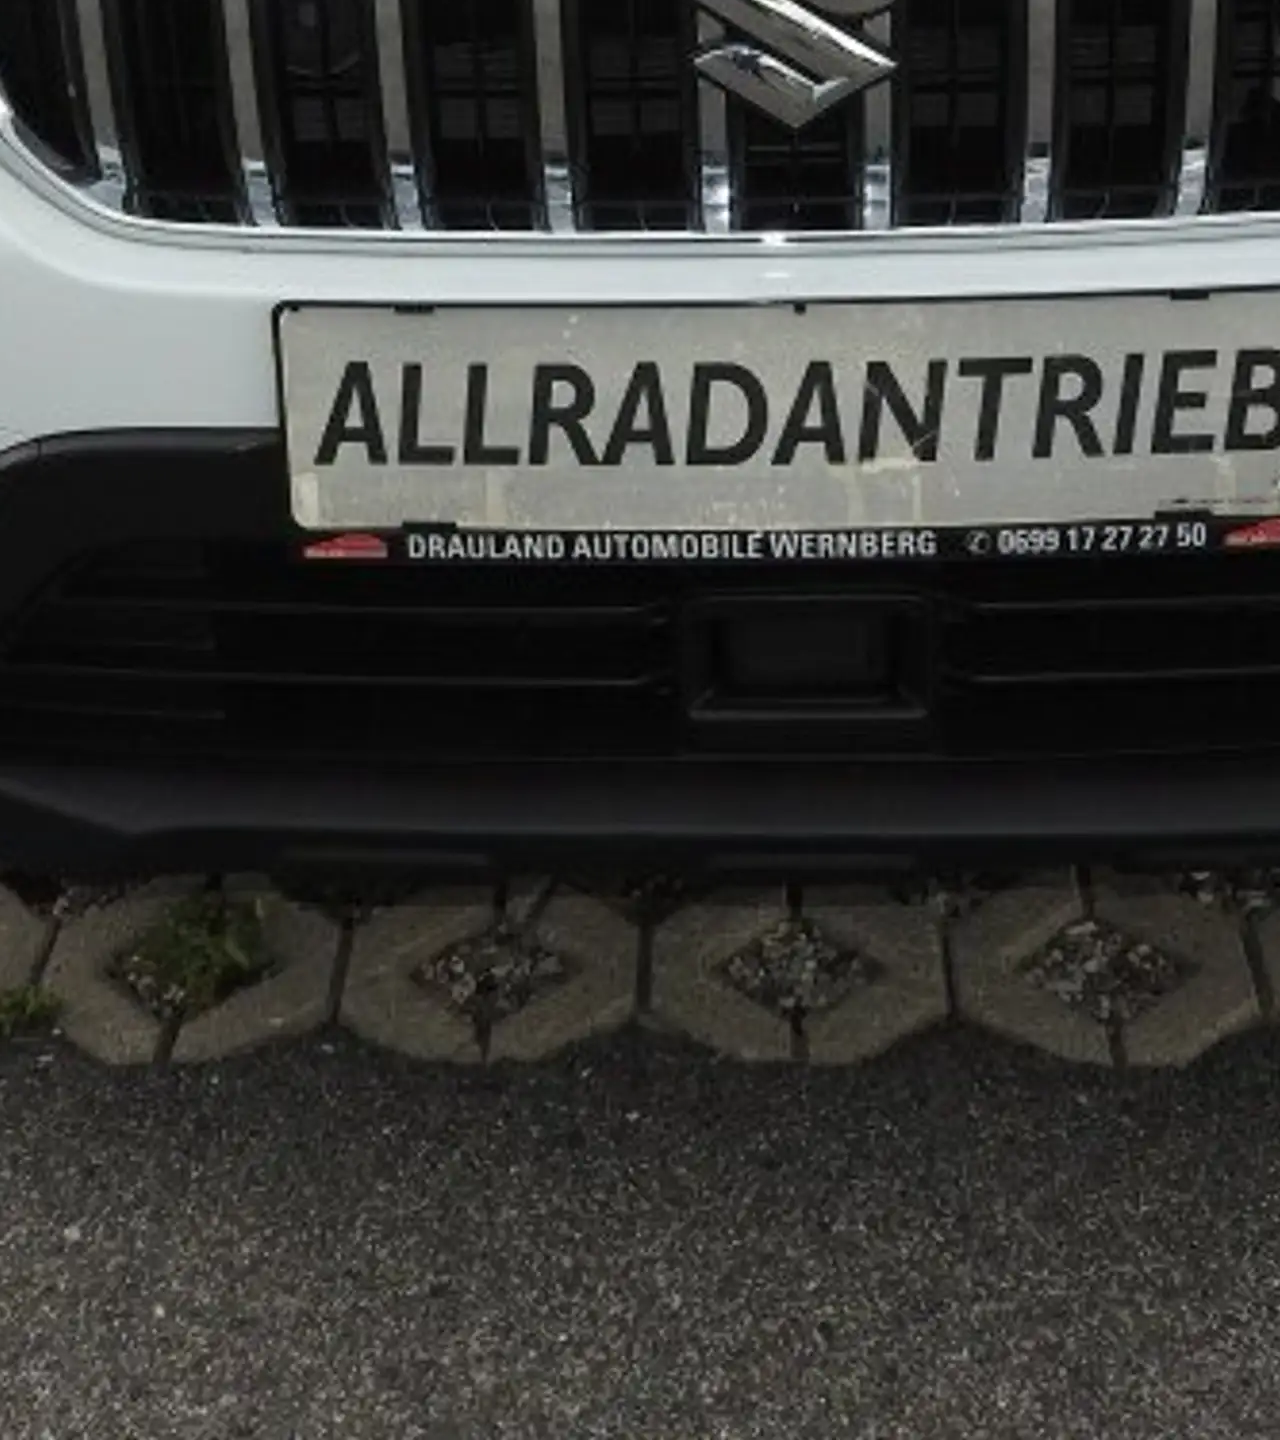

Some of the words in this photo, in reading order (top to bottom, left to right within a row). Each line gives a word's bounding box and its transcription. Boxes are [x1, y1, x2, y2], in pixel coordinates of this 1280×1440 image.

[408, 532, 565, 559] DRAULAND
[571, 531, 765, 559] AUTOMOBILE
[770, 530, 937, 558] WERNBERG
[1067, 525, 1096, 551] 17
[1100, 525, 1133, 552] 27
[1138, 524, 1170, 550] 27
[1176, 522, 1207, 547] 50
